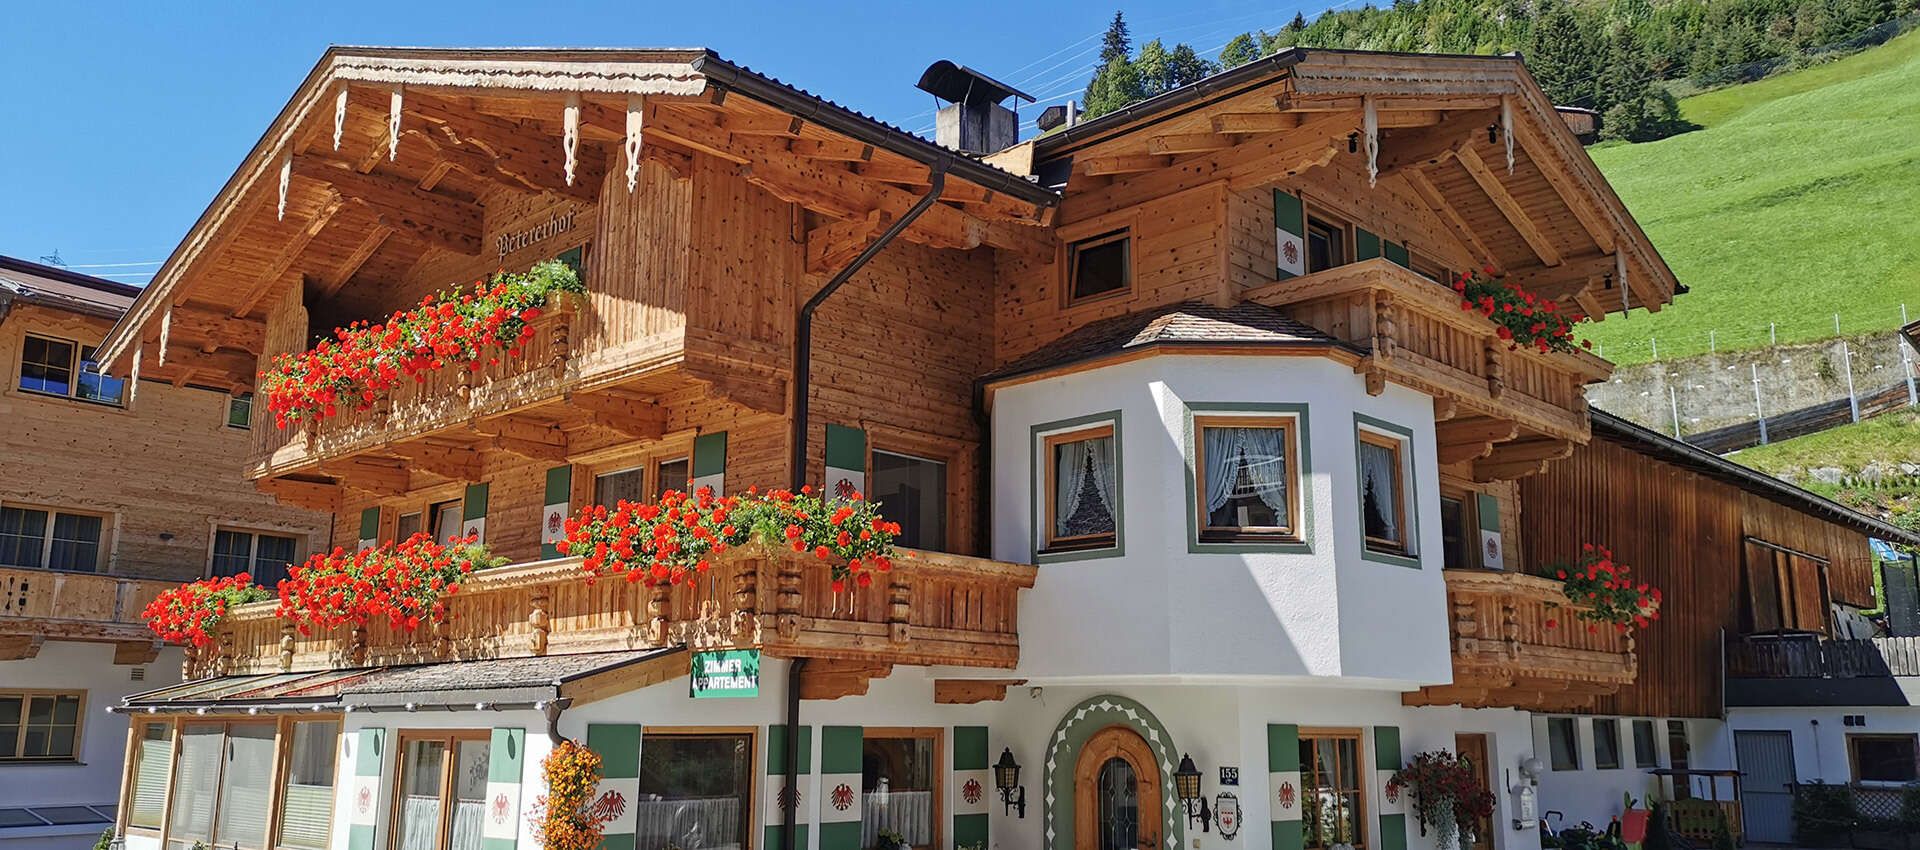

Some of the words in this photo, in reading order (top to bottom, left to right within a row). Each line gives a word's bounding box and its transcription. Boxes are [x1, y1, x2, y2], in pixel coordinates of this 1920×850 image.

[495, 203, 576, 262] Petererhof
[704, 659, 742, 673] ZIMMER
[692, 676, 760, 689] APPARTEMENT
[1221, 768, 1238, 779] 155
